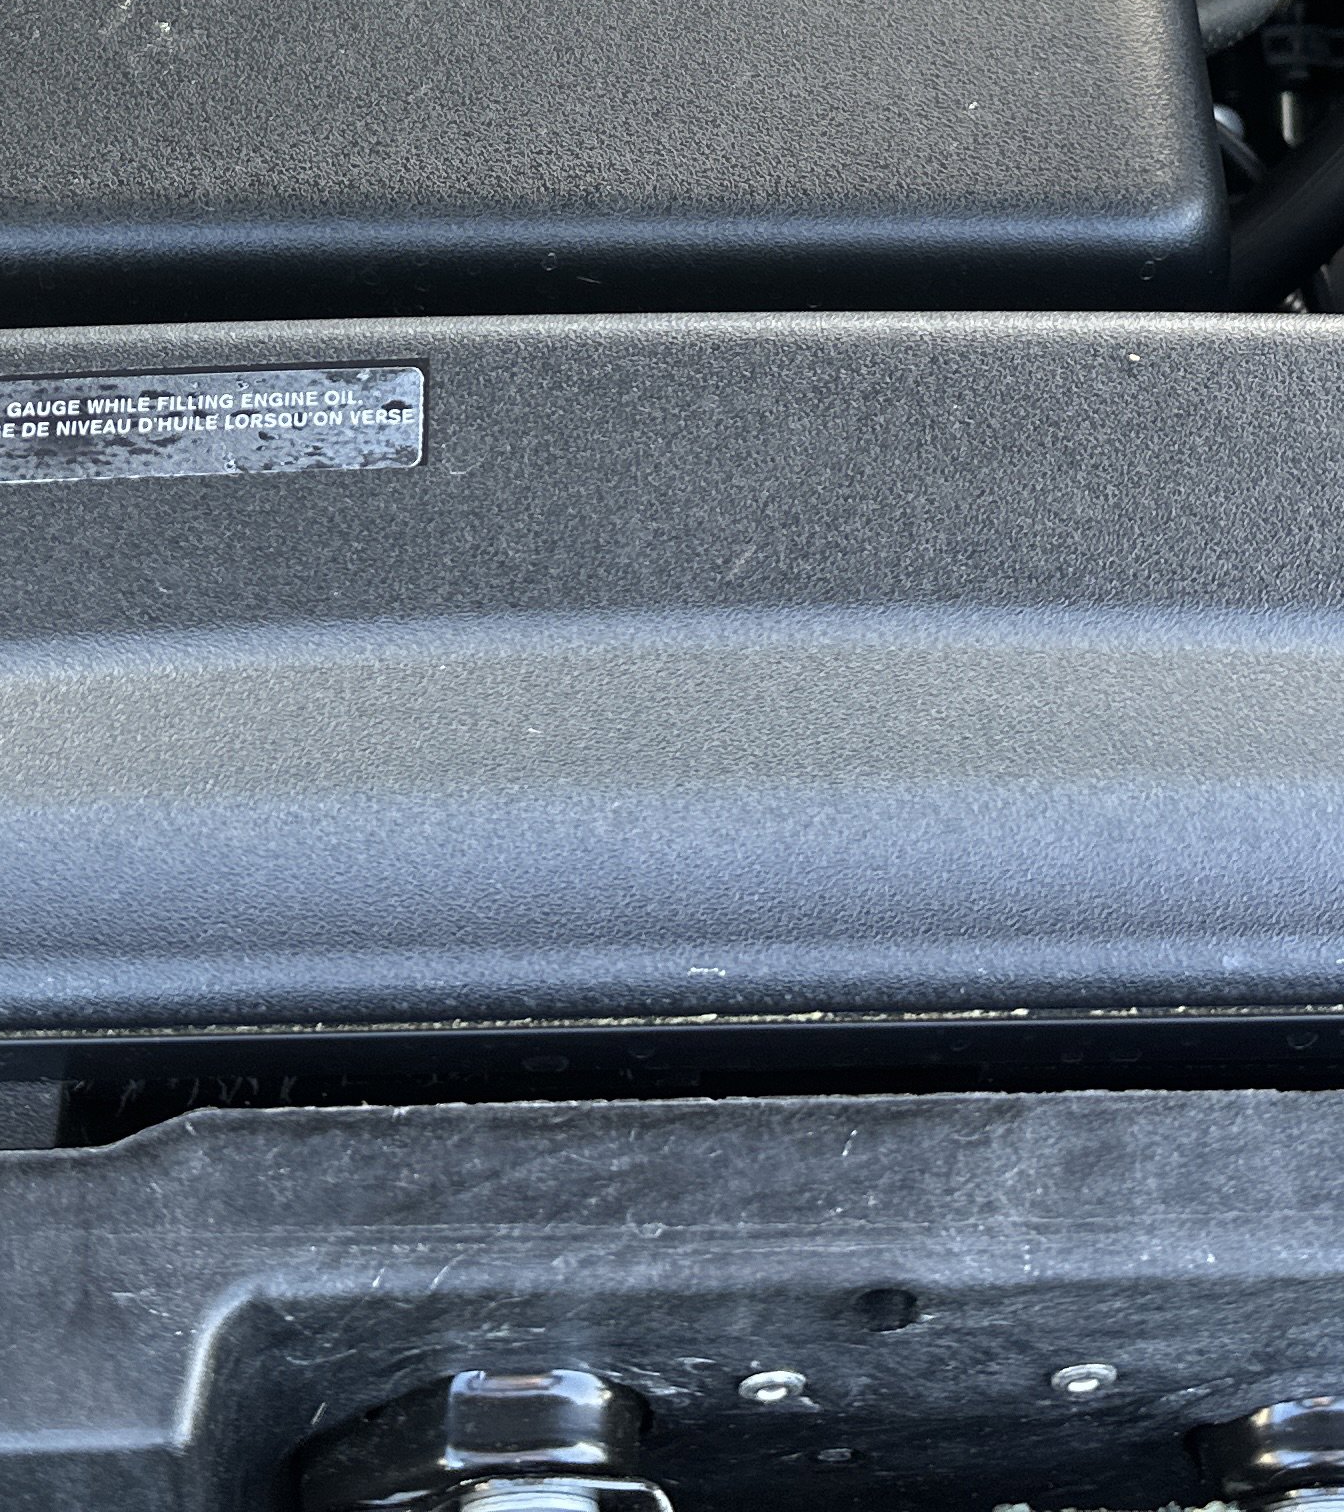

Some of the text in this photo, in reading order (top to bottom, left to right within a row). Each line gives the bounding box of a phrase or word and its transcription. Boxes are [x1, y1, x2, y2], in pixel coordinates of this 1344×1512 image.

[7, 399, 80, 418] GAUGE
[87, 395, 150, 414] WHILE
[156, 393, 234, 412] FILLING
[240, 390, 318, 409] ENGINE
[323, 389, 363, 407] OIL.
[21, 421, 50, 438] DE
[56, 417, 131, 436] NIVEAU
[138, 414, 218, 433] D'HUILE
[224, 410, 343, 430] LORSQU'ON
[349, 408, 416, 426] VERSE
